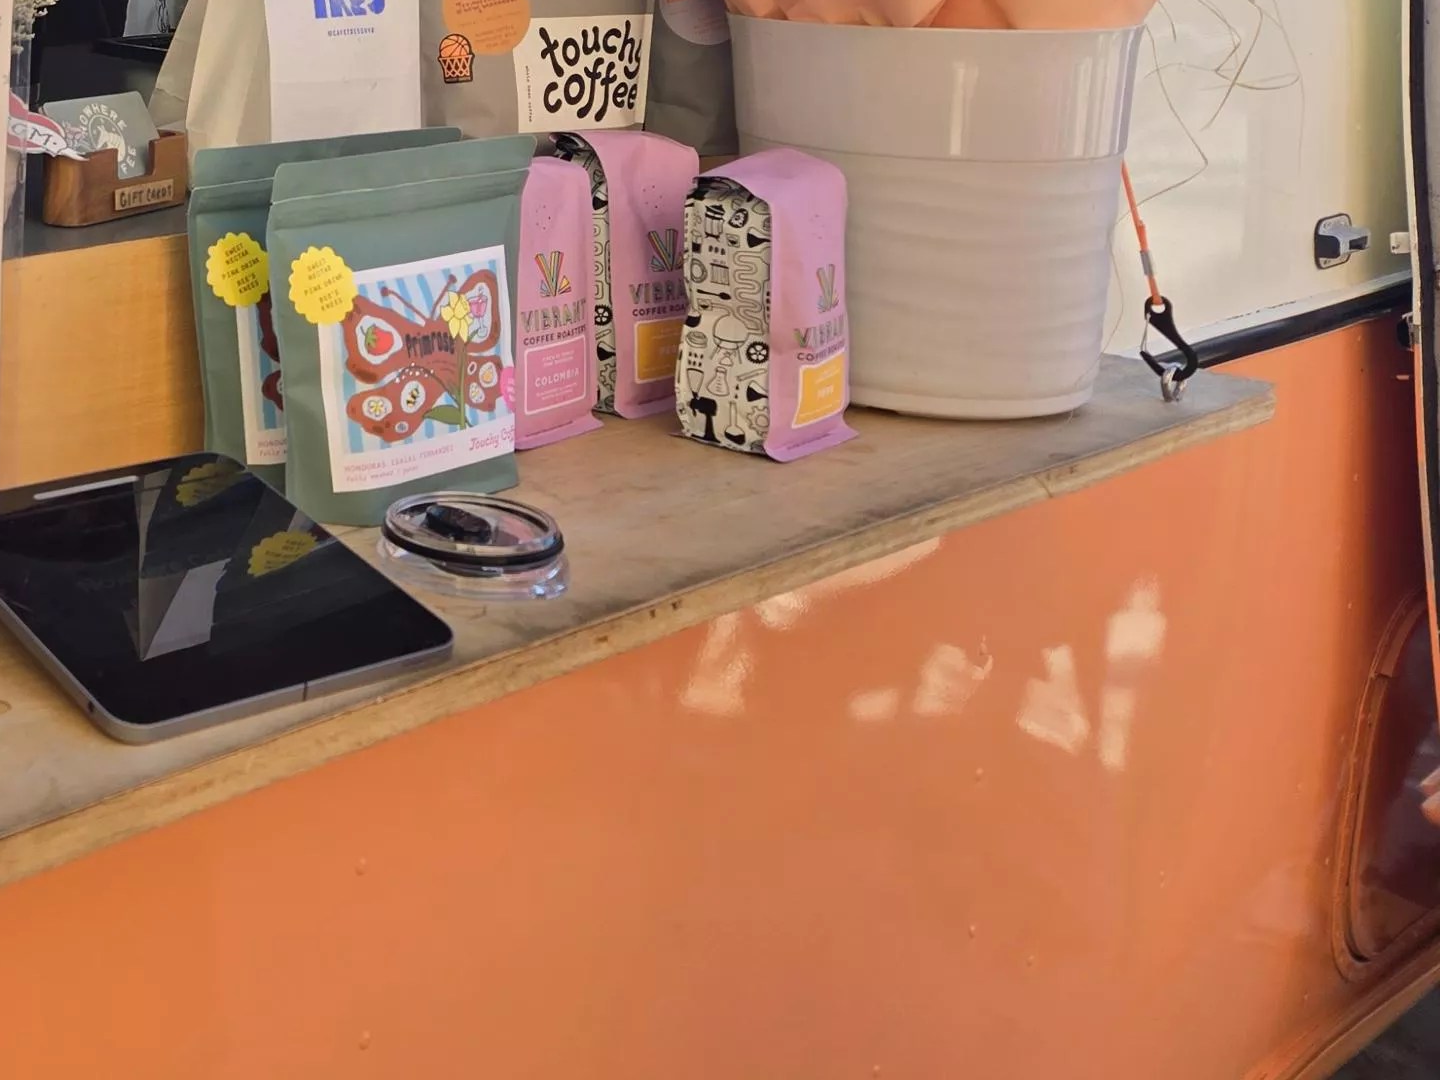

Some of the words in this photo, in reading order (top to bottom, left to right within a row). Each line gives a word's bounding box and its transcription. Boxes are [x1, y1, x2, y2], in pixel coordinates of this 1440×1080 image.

[539, 20, 642, 79] touchy
[543, 57, 638, 122] coffee
[79, 103, 128, 137] NOWHERE
[120, 189, 144, 207] GIFT
[632, 306, 667, 317] COFFEE
[523, 333, 554, 346] COFFEE
